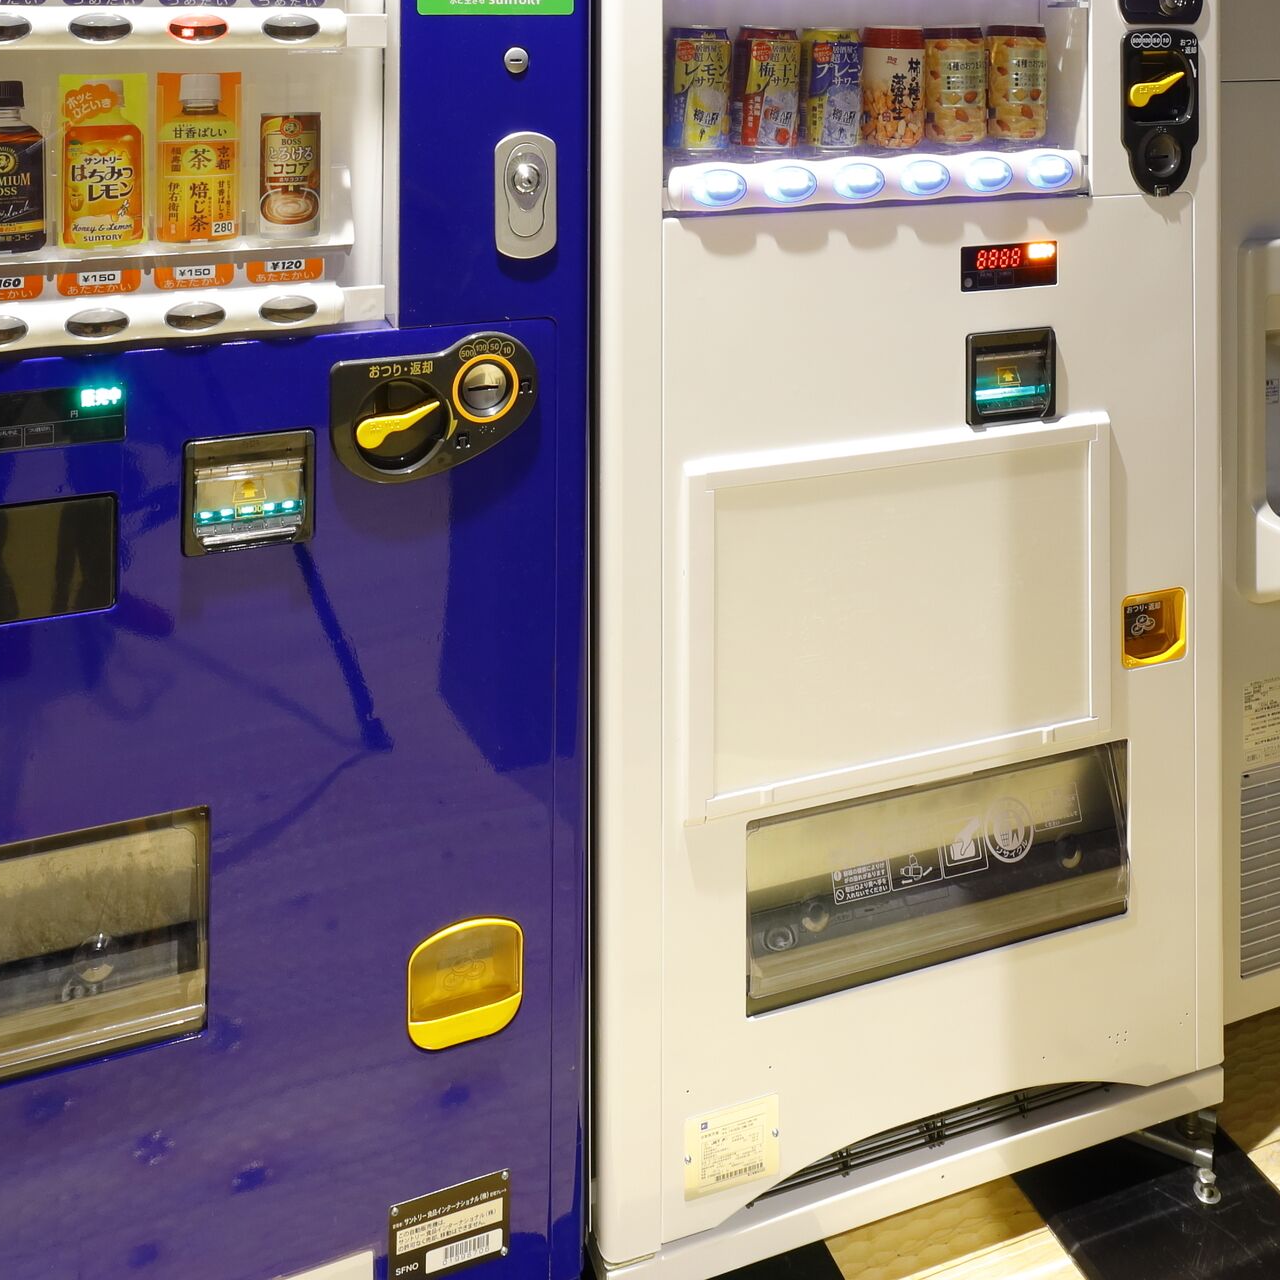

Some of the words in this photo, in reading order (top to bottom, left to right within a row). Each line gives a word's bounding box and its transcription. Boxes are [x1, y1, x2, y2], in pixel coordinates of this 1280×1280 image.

[685, 64, 729, 75] レモン
[760, 64, 798, 77] 梅干し
[832, 78, 859, 87] サワー
[67, 93, 92, 109] ホッと
[891, 74, 907, 120] 落花生
[73, 98, 111, 118] ひといき
[84, 156, 122, 164] サントリー
[188, 149, 212, 170] 茶
[270, 147, 313, 161] とろける
[71, 164, 133, 182] はちみつ
[273, 162, 310, 174] ココア
[88, 183, 134, 201] レモン
[189, 182, 209, 232] 焙じ茶
[72, 223, 96, 233] Honey
[98, 223, 107, 231] &
[108, 223, 133, 231] Lemon
[214, 223, 232, 233] 280
[476, 343, 487, 352] 100
[490, 342, 499, 350] 50
[396, 1262, 418, 1276] SFNO
